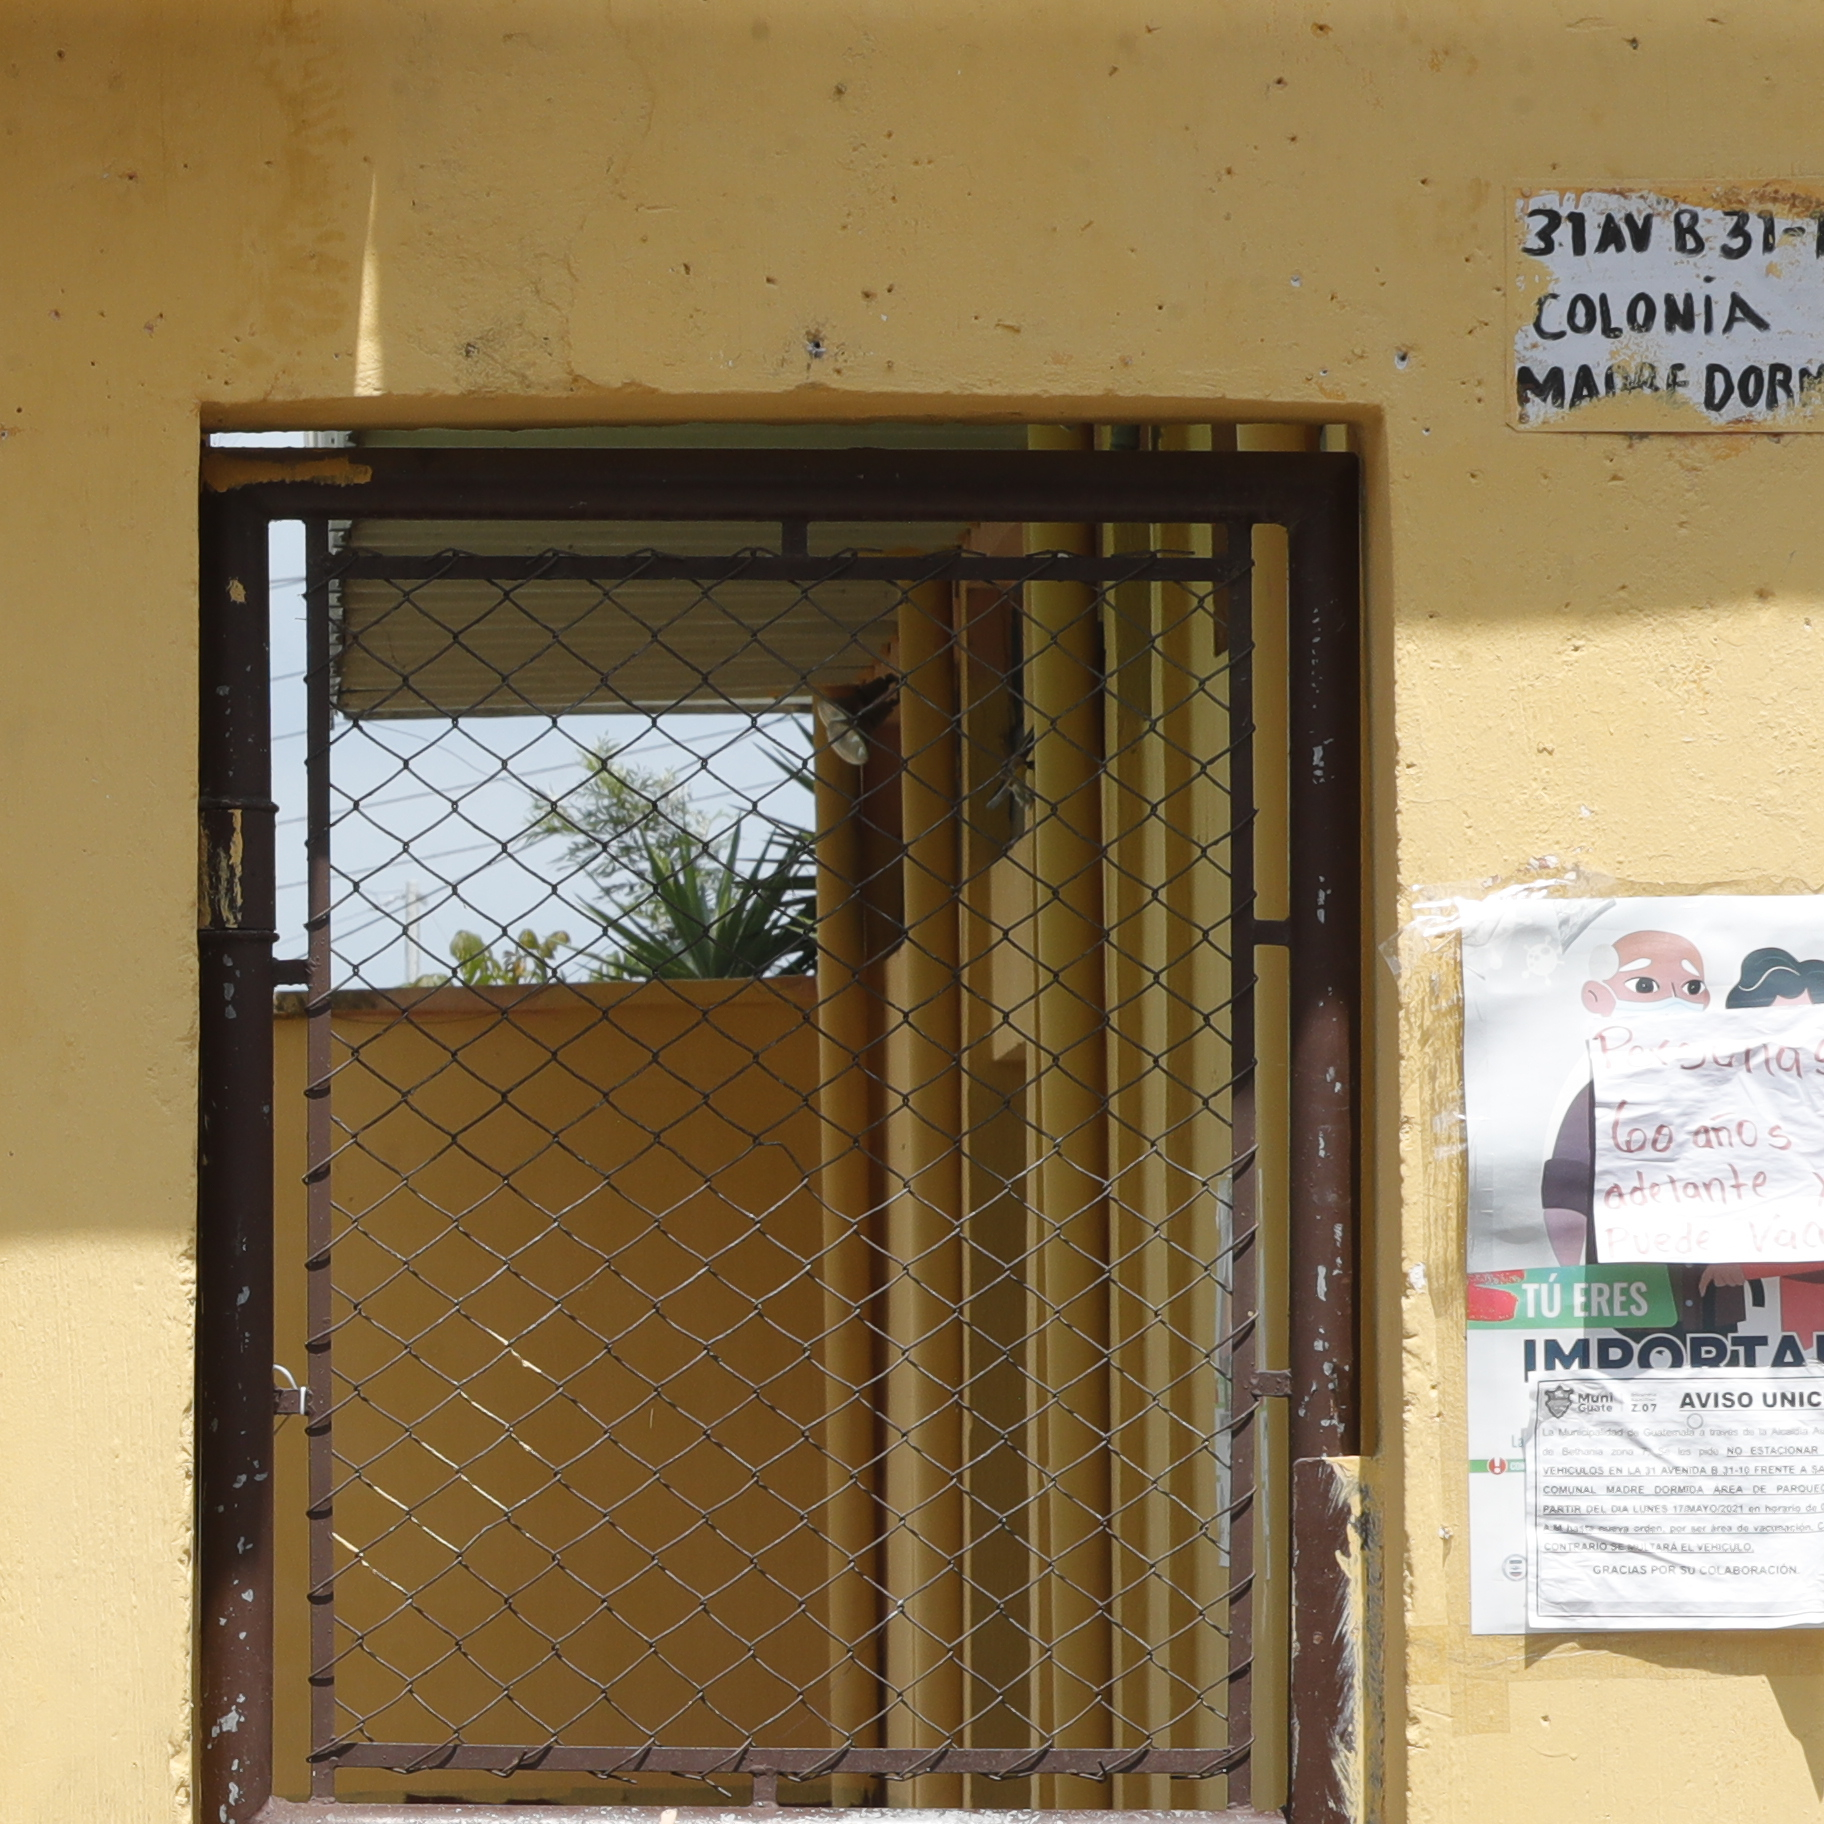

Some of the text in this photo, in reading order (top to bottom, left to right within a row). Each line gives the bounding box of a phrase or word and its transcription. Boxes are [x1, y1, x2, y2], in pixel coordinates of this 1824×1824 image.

[1673, 209, 1705, 257] B
[1533, 275, 1770, 340] COLONIA
[1522, 1273, 1648, 1317] TÚ ERES
[1524, 1333, 1824, 1382] IMPORTA
[1679, 1392, 1753, 1408] AVISO
[1542, 1485, 1596, 1494] COMUNAL
[1606, 1485, 1644, 1494] MADRE
[1542, 1504, 1581, 1513] PARTIR
[1593, 1566, 1647, 1574] GRACIAS
[1651, 1566, 1676, 1574] POR
